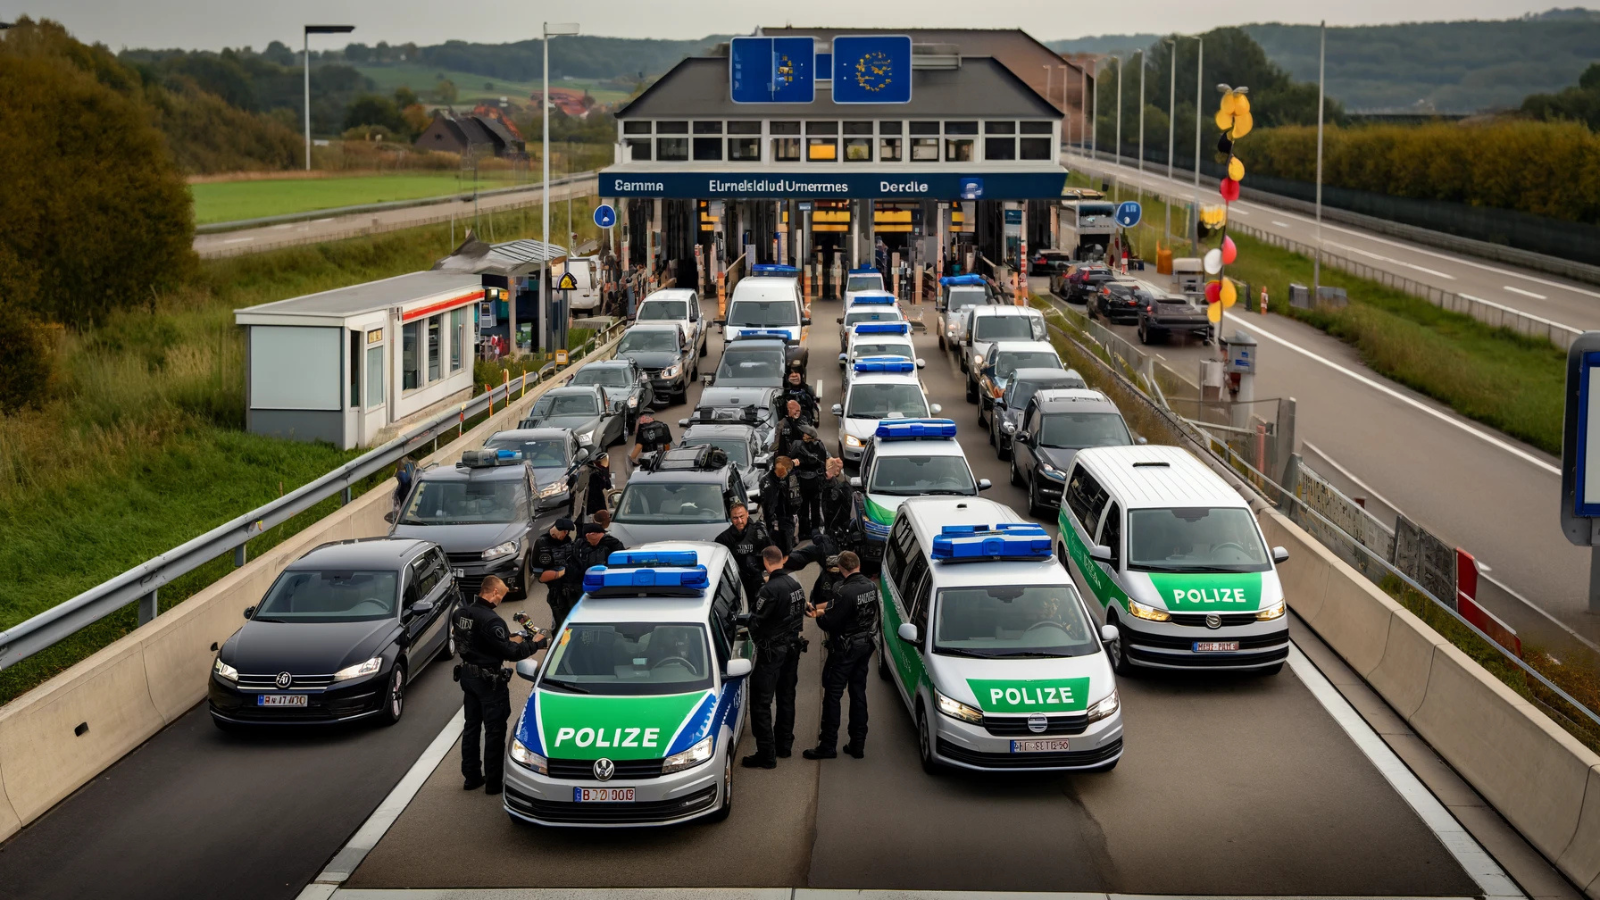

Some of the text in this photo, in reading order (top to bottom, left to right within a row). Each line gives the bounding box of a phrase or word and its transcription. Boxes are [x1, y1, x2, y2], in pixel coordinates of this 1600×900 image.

[1172, 587, 1247, 604] POLIZE
[989, 685, 1075, 706] POLIZE
[554, 727, 660, 748] POLIZE
